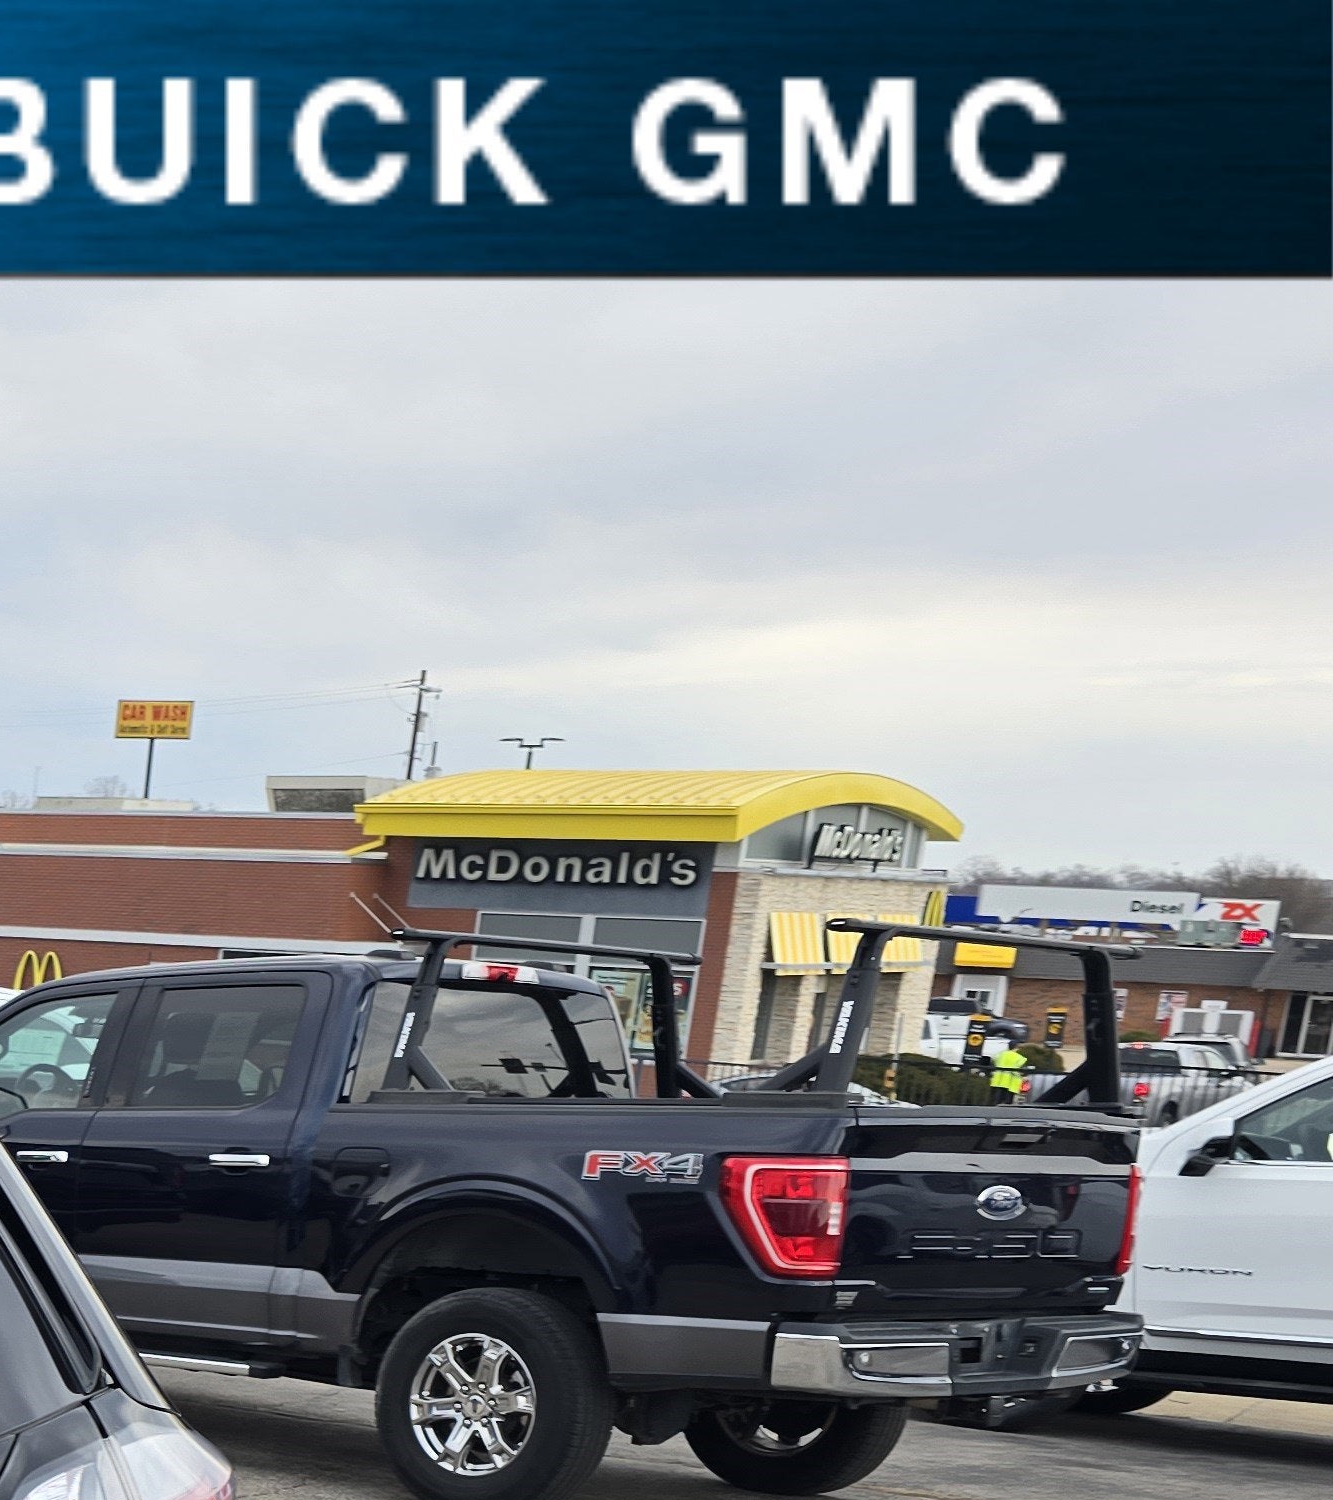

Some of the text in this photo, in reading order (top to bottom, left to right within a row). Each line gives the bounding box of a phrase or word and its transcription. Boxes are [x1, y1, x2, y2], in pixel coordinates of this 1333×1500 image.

[122, 704, 189, 721] CAR WASH
[415, 848, 697, 886] McDonald's
[1131, 900, 1183, 914] Diesel
[828, 1000, 855, 1055] YAKIMA
[581, 1150, 704, 1181] FX4
[1141, 1264, 1253, 1277] YUKON
